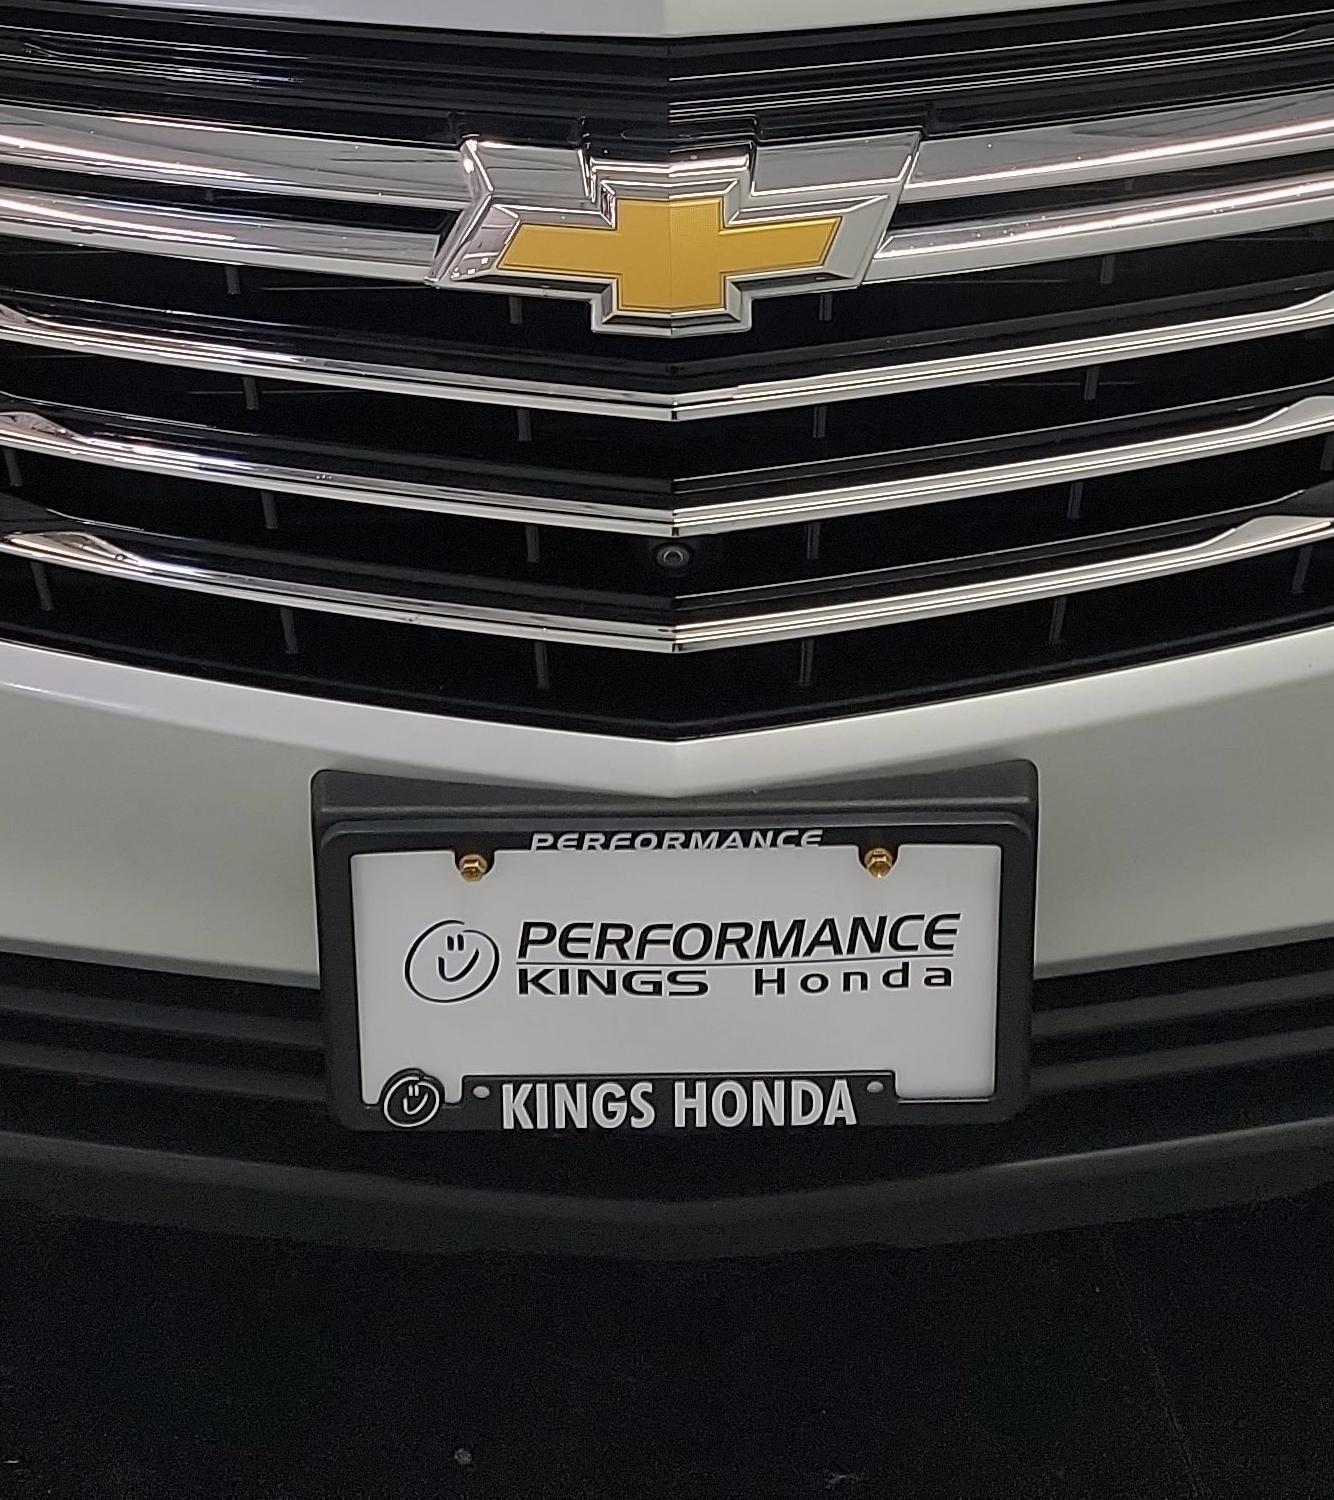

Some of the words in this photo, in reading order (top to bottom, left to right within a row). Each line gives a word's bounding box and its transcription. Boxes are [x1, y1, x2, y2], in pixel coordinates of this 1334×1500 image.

[530, 829, 823, 851] PERFORMANCE
[517, 912, 961, 960] PERFORMANCE
[517, 968, 709, 997] KINGS
[754, 961, 953, 995] Honda
[502, 1082, 656, 1129] KINGS
[675, 1080, 857, 1128] HONDA
